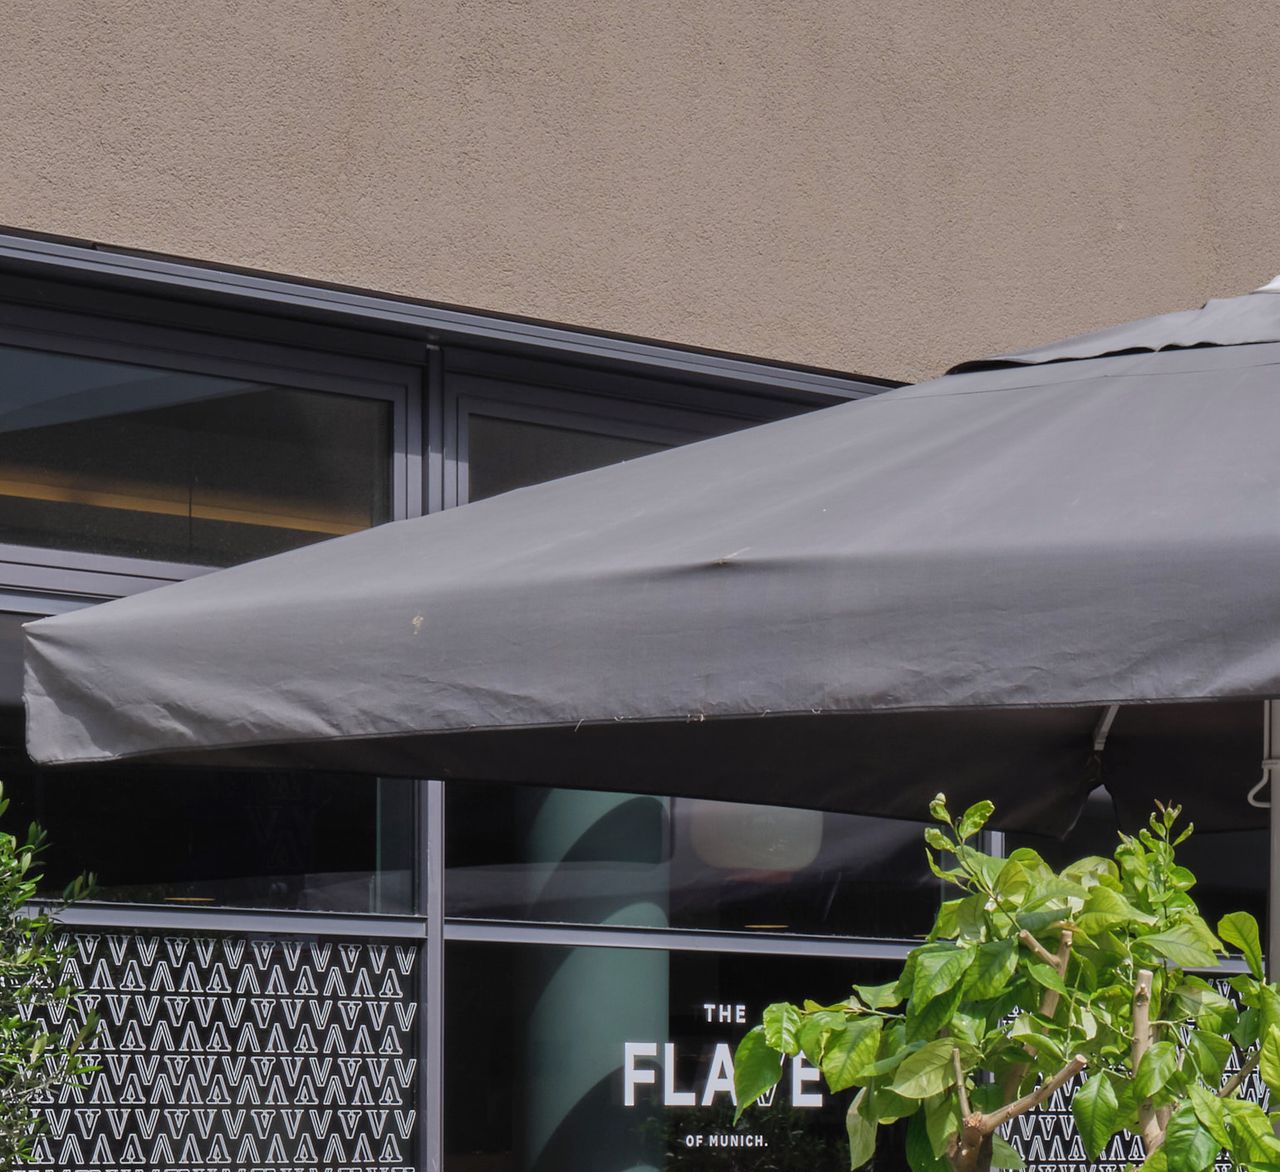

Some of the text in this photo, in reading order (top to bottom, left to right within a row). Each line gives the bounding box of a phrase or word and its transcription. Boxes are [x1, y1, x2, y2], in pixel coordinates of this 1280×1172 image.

[704, 1003, 746, 1023] THE
[686, 1135, 768, 1147] OF MUNICH.
